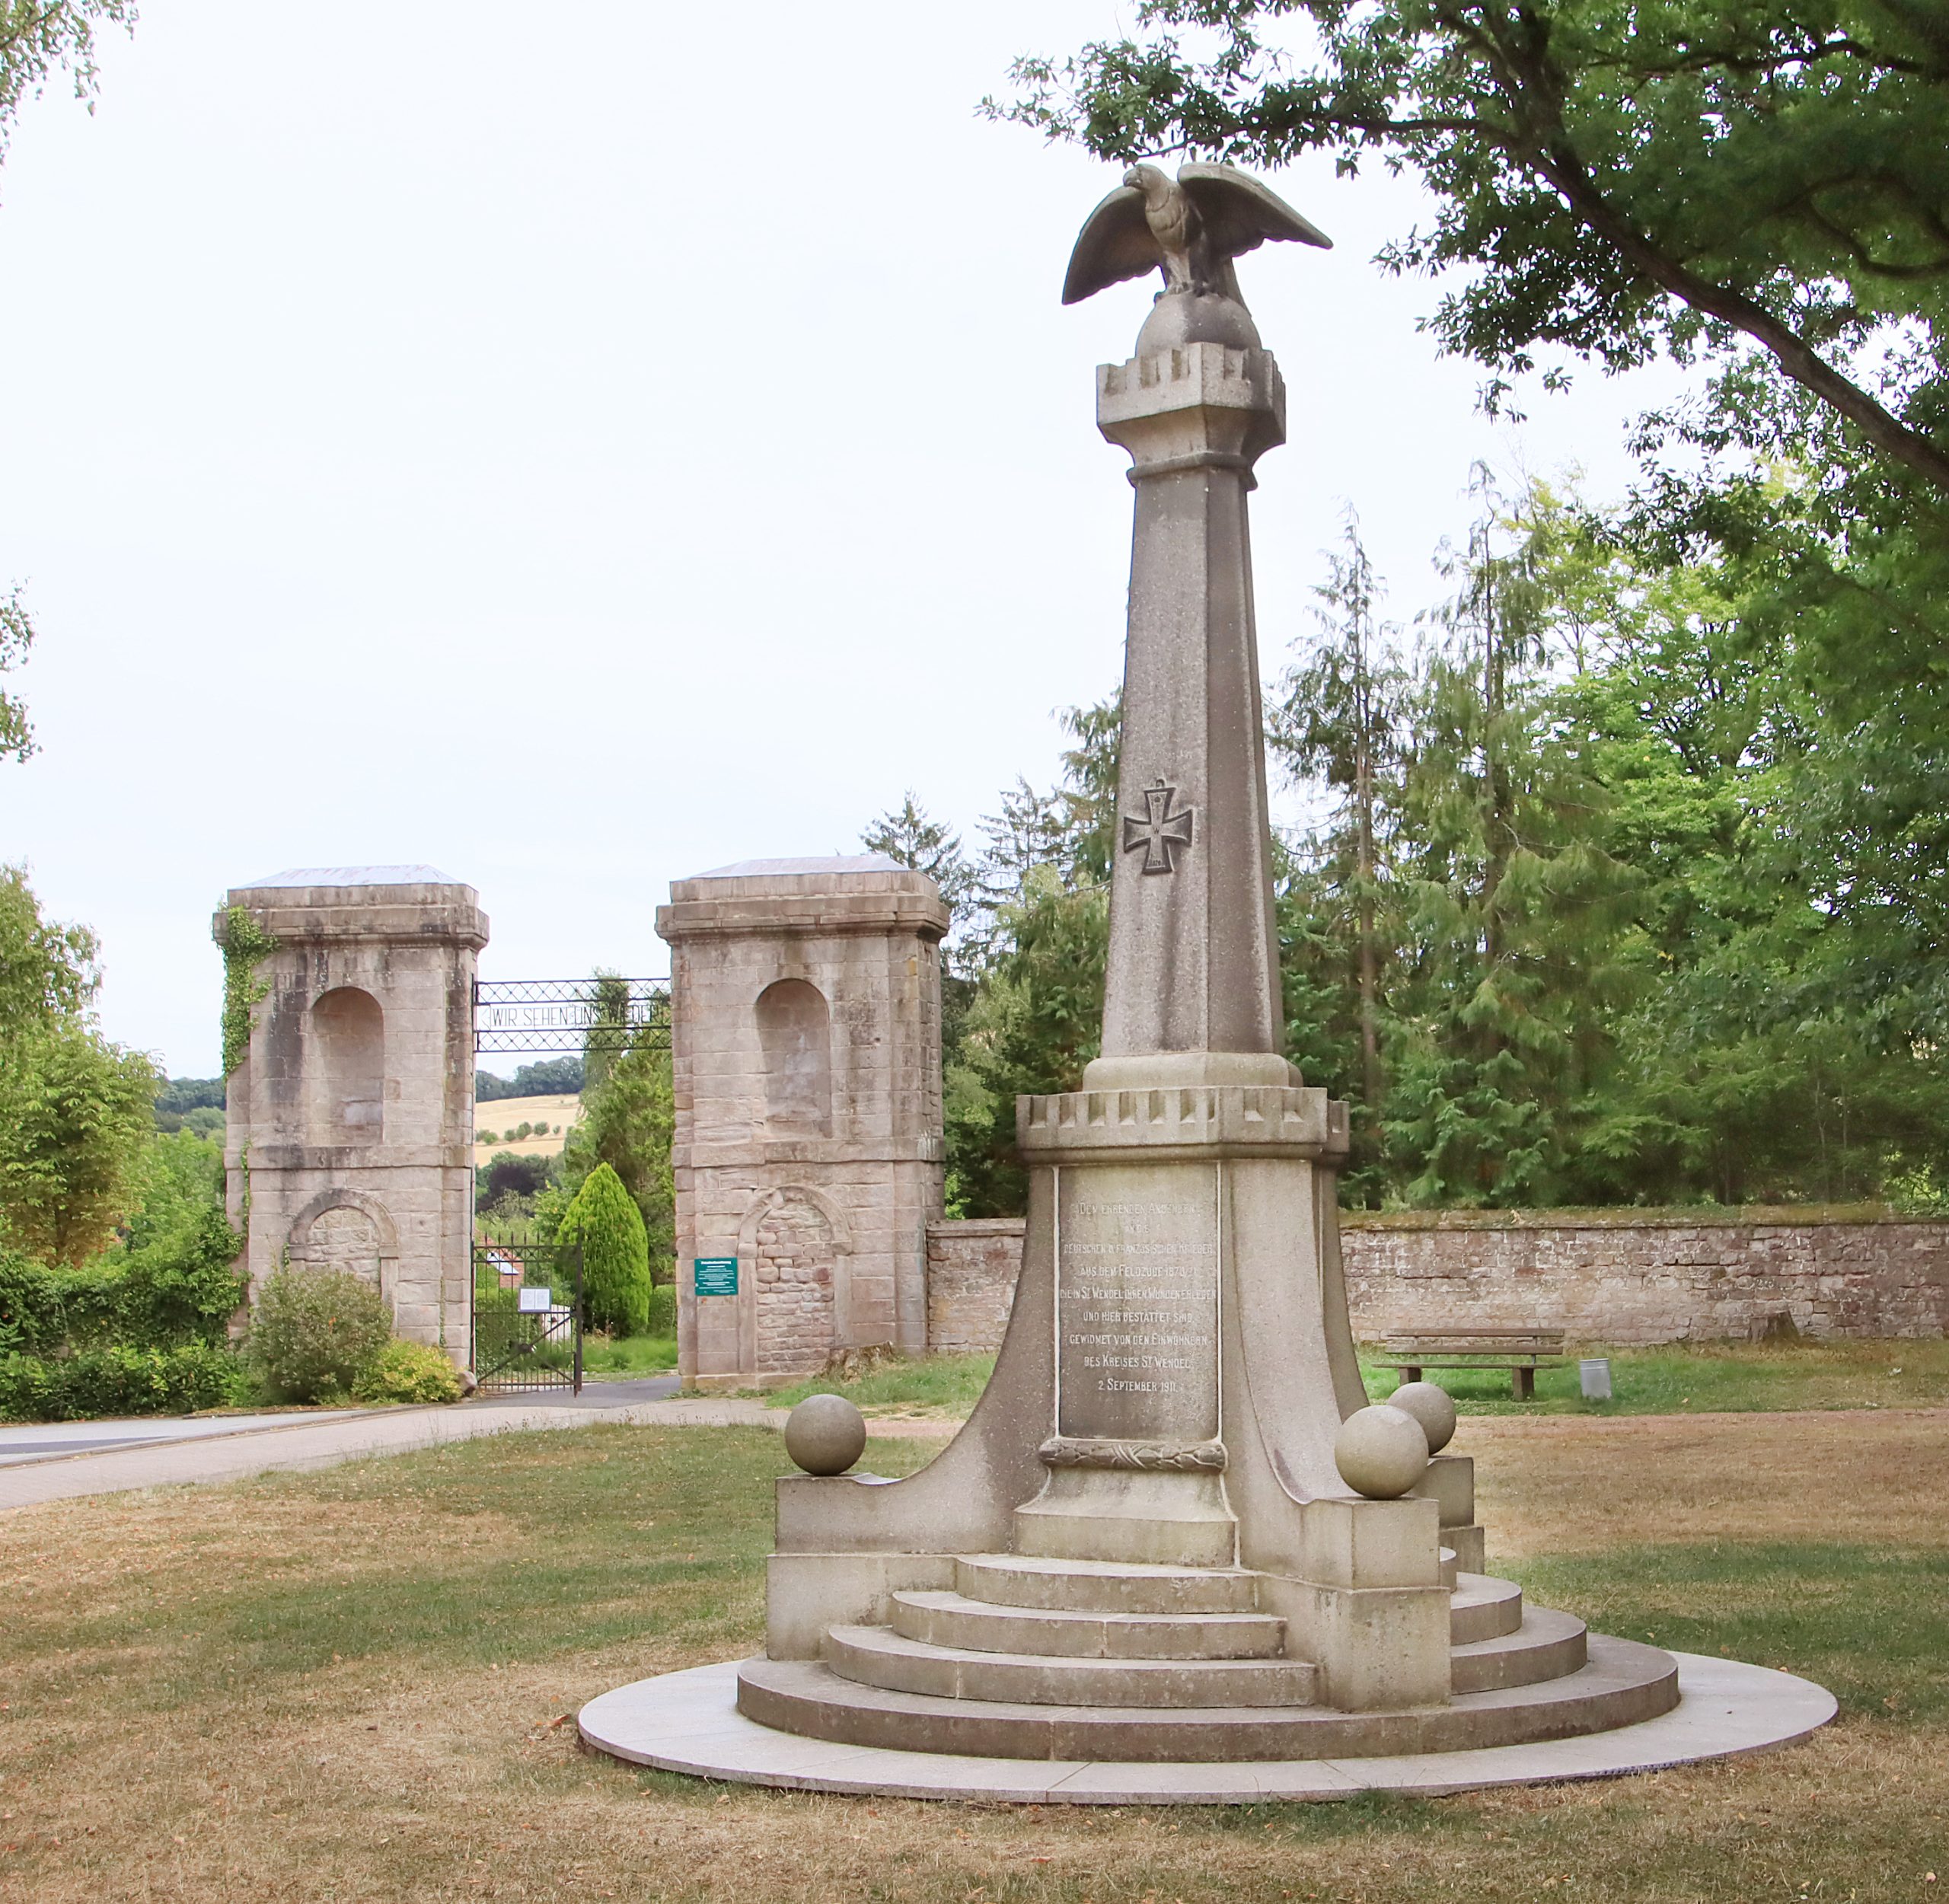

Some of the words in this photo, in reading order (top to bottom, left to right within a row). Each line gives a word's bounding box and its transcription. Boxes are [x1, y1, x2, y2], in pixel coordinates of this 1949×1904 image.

[492, 1008, 517, 1026] WIR
[524, 1006, 568, 1025] SEHEN
[574, 1005, 600, 1025] UNS
[1080, 1266, 1097, 1277] AUS
[1119, 1264, 1163, 1277] FELDZUGE
[1092, 1286, 1123, 1299] WENDEL
[1148, 1287, 1180, 1300] WUNDEN
[1083, 1311, 1099, 1322] UND
[1102, 1311, 1121, 1322] HIER
[1123, 1311, 1171, 1322] BESTATTET
[1070, 1334, 1112, 1345] GEWIDMET
[1114, 1334, 1131, 1345] VON
[1133, 1335, 1150, 1345] DEN
[1084, 1356, 1100, 1367] DES
[1102, 1354, 1139, 1367] KREISES
[1107, 1378, 1157, 1392] SEPTEMBER
